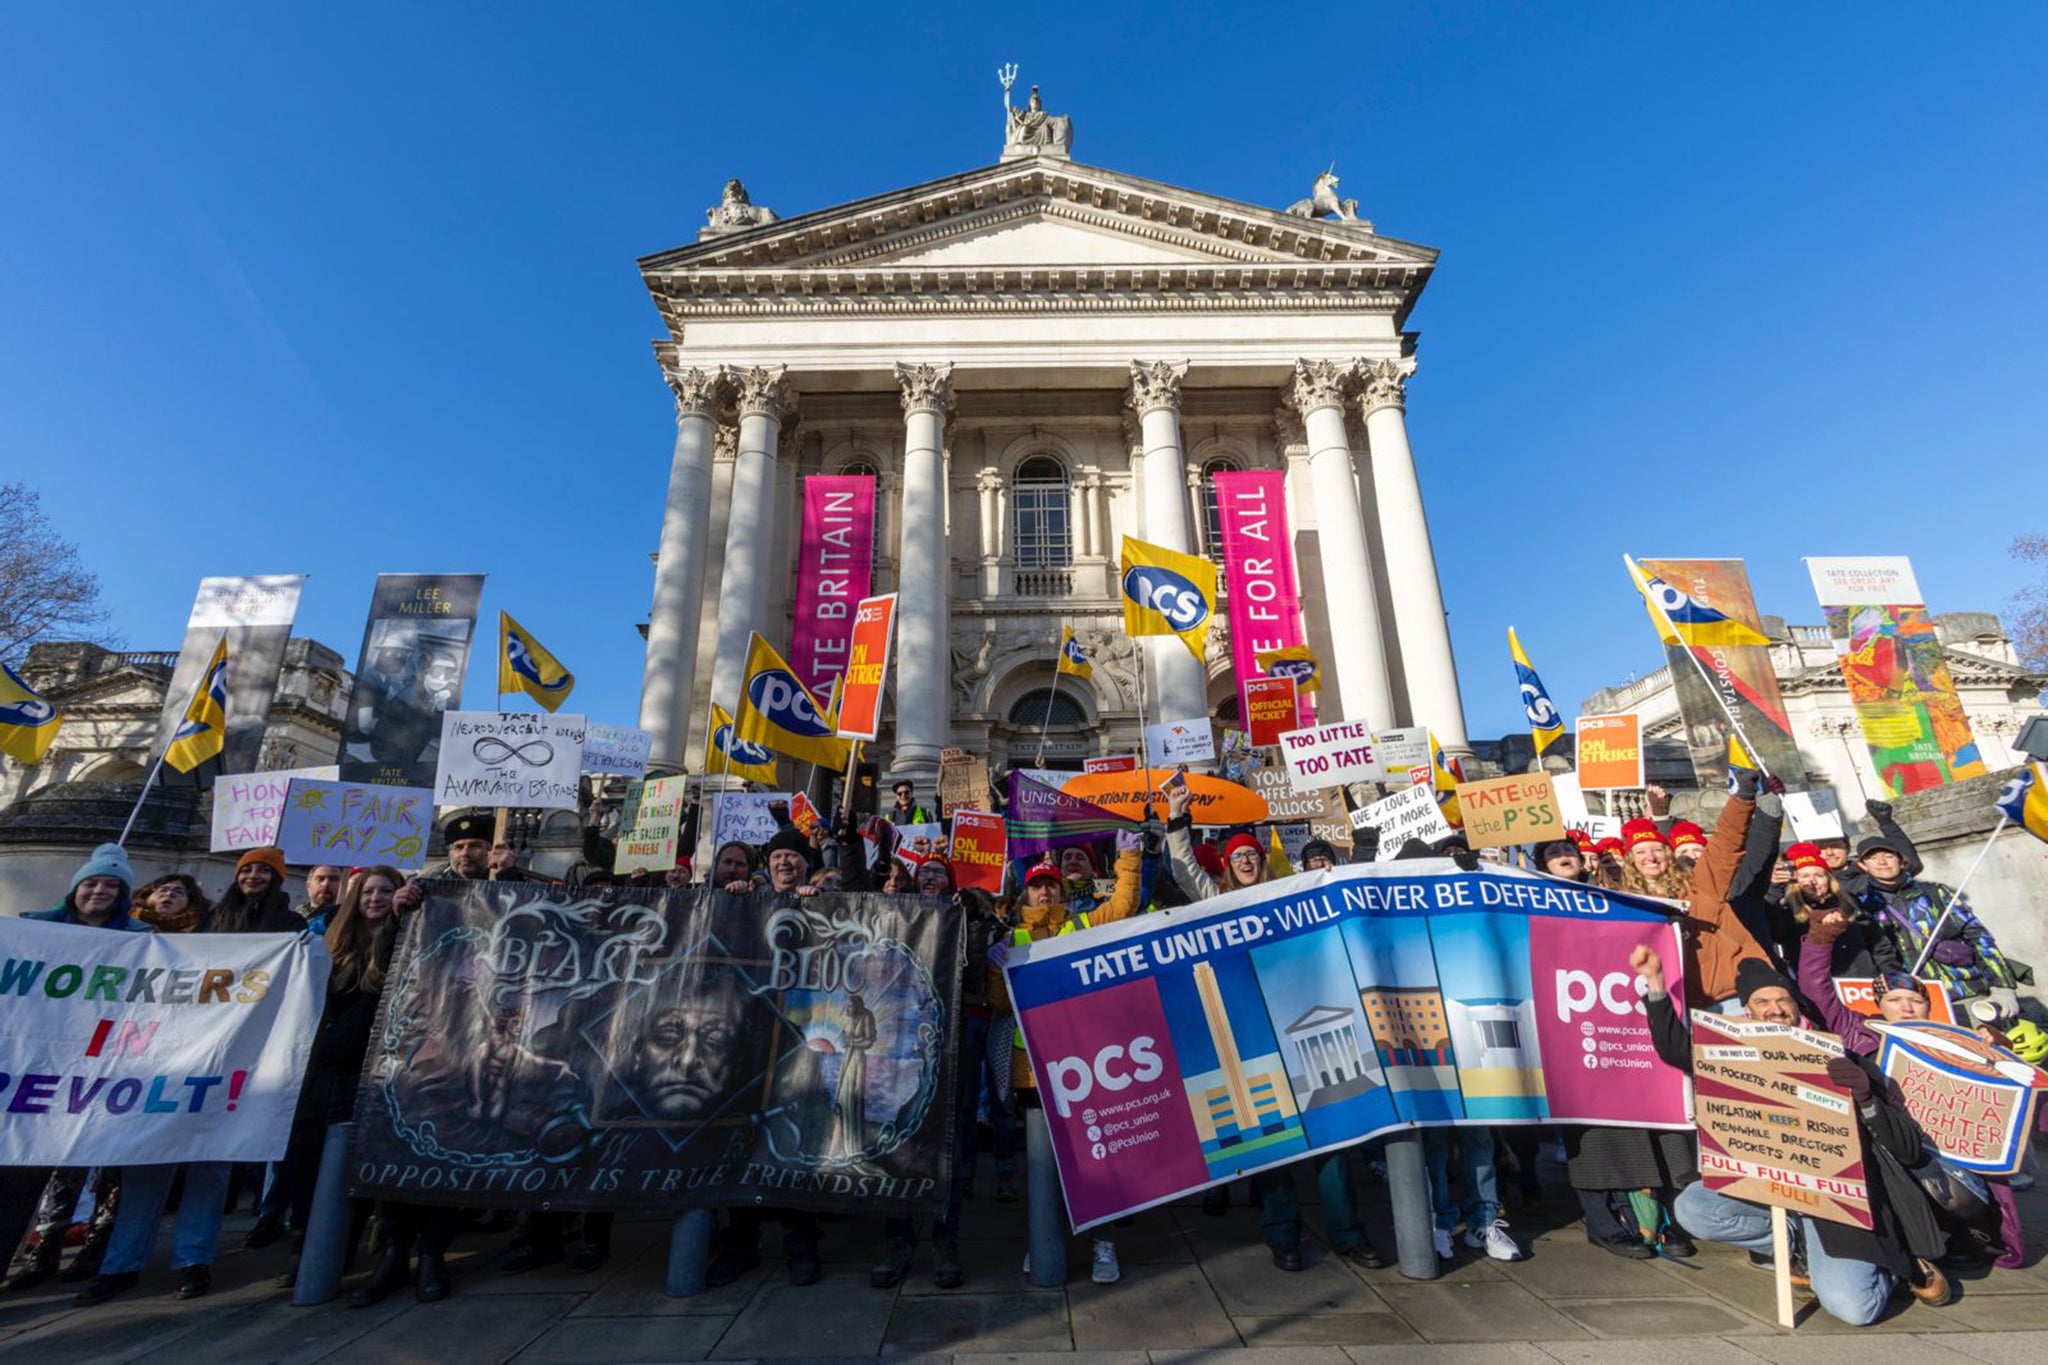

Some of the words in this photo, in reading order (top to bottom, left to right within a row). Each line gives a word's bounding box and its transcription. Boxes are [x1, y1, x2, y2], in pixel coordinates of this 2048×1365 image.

[1236, 486, 1270, 541] ALL
[817, 492, 854, 619] BRITAIN
[1848, 569, 1899, 577] COLLECTION
[416, 588, 440, 600] LEE
[1244, 558, 1279, 620] FOR
[399, 602, 452, 613] MILLER
[852, 644, 868, 664] ON
[811, 638, 846, 700] ATE
[846, 663, 883, 685] STRIKE
[1248, 683, 1268, 694] pcs
[1250, 699, 1294, 712] OFFICIAL
[1520, 683, 1556, 724] cs
[498, 712, 538, 722] TATE
[1250, 710, 1287, 721] PICKET
[1580, 720, 1604, 731] pcs
[1285, 734, 1316, 749] TOO
[1319, 723, 1365, 743] LITTLE
[1014, 743, 1041, 751] TATE
[1046, 742, 1083, 751] BRITAIN
[1580, 739, 1606, 753] ON
[1908, 751, 1944, 760] BRITAIN
[1913, 743, 1933, 751] TATE
[1295, 756, 1329, 776] TOO
[1331, 746, 1374, 768] TATE
[1580, 748, 1637, 764] STRIKE
[379, 769, 402, 777] TATE
[485, 766, 517, 779] THE
[1412, 769, 1430, 783] pc
[528, 779, 578, 799] BRIGADE
[1460, 783, 1549, 809] TATEing
[341, 788, 419, 826] FAIR
[1022, 790, 1080, 809] UNISON
[1268, 799, 1325, 816] OLLOCKS
[1352, 809, 1371, 826] WE
[1384, 793, 1411, 812] LOVE
[1413, 786, 1426, 800] TO
[724, 813, 749, 827] PAY
[956, 816, 980, 828] pcs
[1400, 803, 1433, 826] MORE
[226, 825, 274, 846] FAIR
[312, 822, 377, 852] PAY
[732, 829, 774, 841] RENT
[1473, 819, 1501, 836] the
[1633, 832, 1656, 841] pcs
[954, 837, 977, 850] ON
[1676, 834, 1696, 844] pcs
[952, 851, 1004, 866] STRIKE
[1032, 863, 1050, 873] pcs
[1796, 856, 1816, 866] pcs
[1070, 944, 1149, 985] TATE
[1151, 915, 1274, 965] UNITED:
[1274, 891, 1341, 931] WILL
[1342, 884, 1429, 910] NEVER
[1434, 881, 1473, 908] BE
[1479, 881, 1610, 914] DEFEATED
[500, 926, 662, 986] BLAKE
[768, 944, 868, 994] BLOC
[0, 958, 270, 1004] WORKERS
[1843, 987, 1874, 1004] pc
[85, 1019, 160, 1057] IN
[1766, 1025, 1778, 1033] NOT
[1598, 1040, 1654, 1053] @pcs_union
[1804, 1034, 1815, 1044] DO
[1816, 1039, 1830, 1049] NOT
[1600, 1057, 1652, 1069] @PcsUnion
[1719, 1050, 1729, 1058] DO
[1762, 1050, 1788, 1062] OUR
[1790, 1053, 1832, 1066] WAGES
[1046, 1036, 1163, 1118] pcs
[1696, 1060, 1717, 1074] OUR
[1720, 1066, 1767, 1087] POCKETS
[1771, 1082, 1798, 1096] ARE
[1805, 1091, 1845, 1110] EMPTY
[1907, 1061, 1936, 1086] WE
[1950, 1080, 2006, 1108] WILL
[1098, 1088, 1172, 1118] www.pcs.org.uk
[1900, 1076, 1973, 1115] PAINT
[1981, 1107, 2002, 1125] A
[1103, 1111, 1160, 1136] @pcs_union
[1706, 1101, 1762, 1121] INFLATION
[1768, 1113, 1801, 1127] KEEPS
[1807, 1119, 1850, 1137] RISING
[1905, 1098, 2003, 1145] RIGHTER
[1712, 1120, 1771, 1139] MEANWHILE
[1108, 1130, 1160, 1154] @PcsUnion
[1924, 1128, 1986, 1159] TURE
[1728, 1137, 1784, 1159] POCKETS
[1790, 1152, 1822, 1169] ARE
[359, 1162, 582, 1192] OPPOSITION
[588, 1168, 626, 1192] IS
[640, 1163, 730, 1192] TRUE
[739, 1162, 935, 1198] FRIENDSHIP
[1701, 1154, 1748, 1174] FULL
[1757, 1166, 1807, 1187] FULL
[1816, 1178, 1868, 1200] FULL
